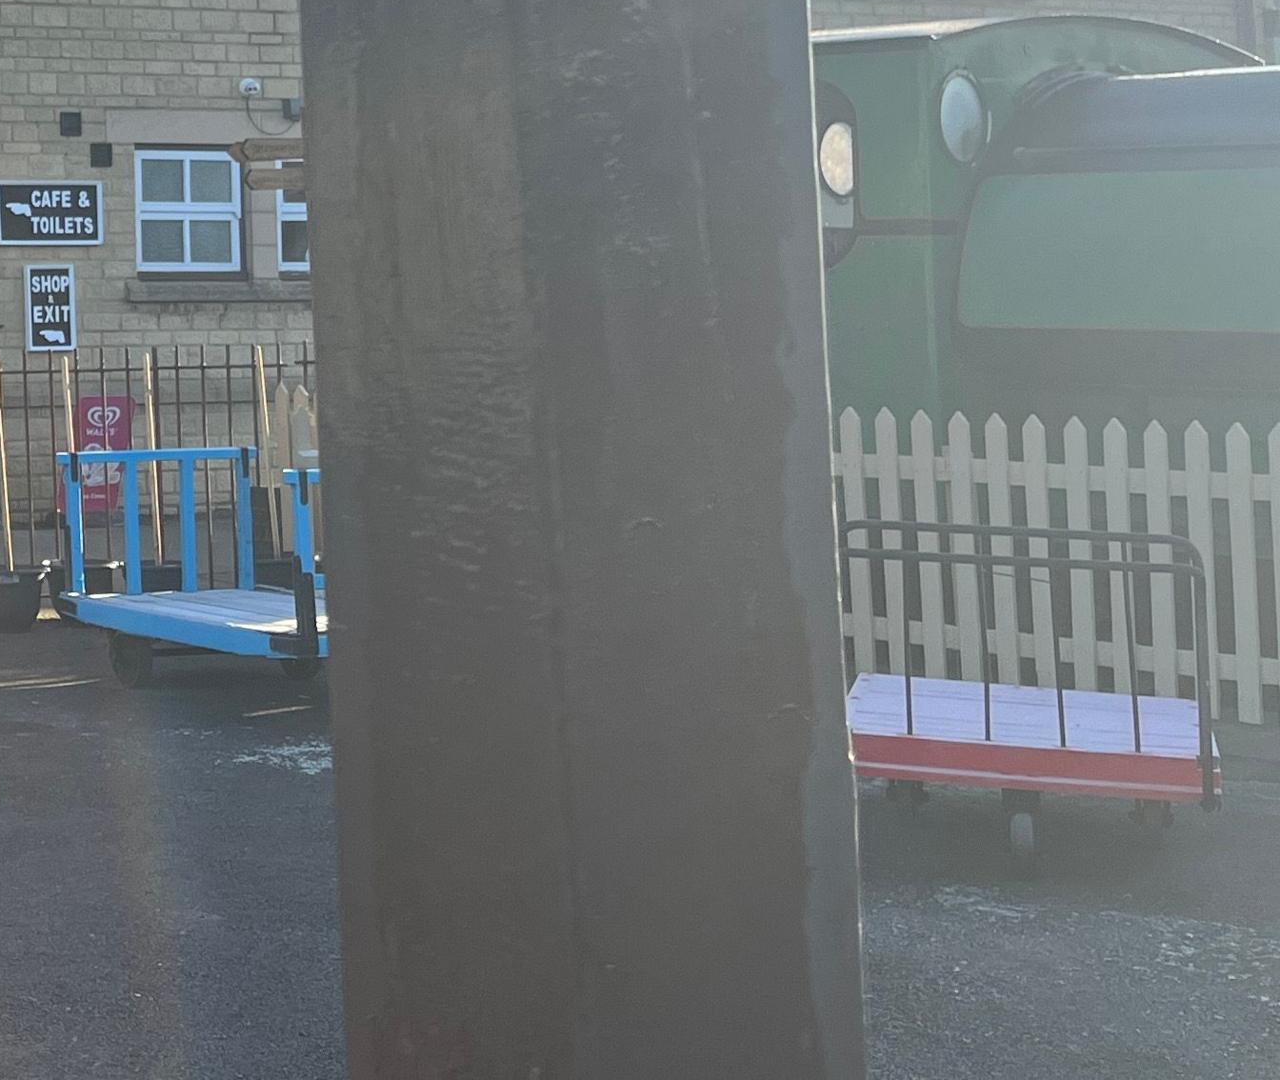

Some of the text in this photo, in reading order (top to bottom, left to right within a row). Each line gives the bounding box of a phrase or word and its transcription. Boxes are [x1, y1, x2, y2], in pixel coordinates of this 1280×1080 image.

[31, 190, 91, 208] CAFE &
[31, 216, 94, 234] TOILETS
[31, 275, 70, 293] SHOP
[33, 305, 70, 323] EXIT
